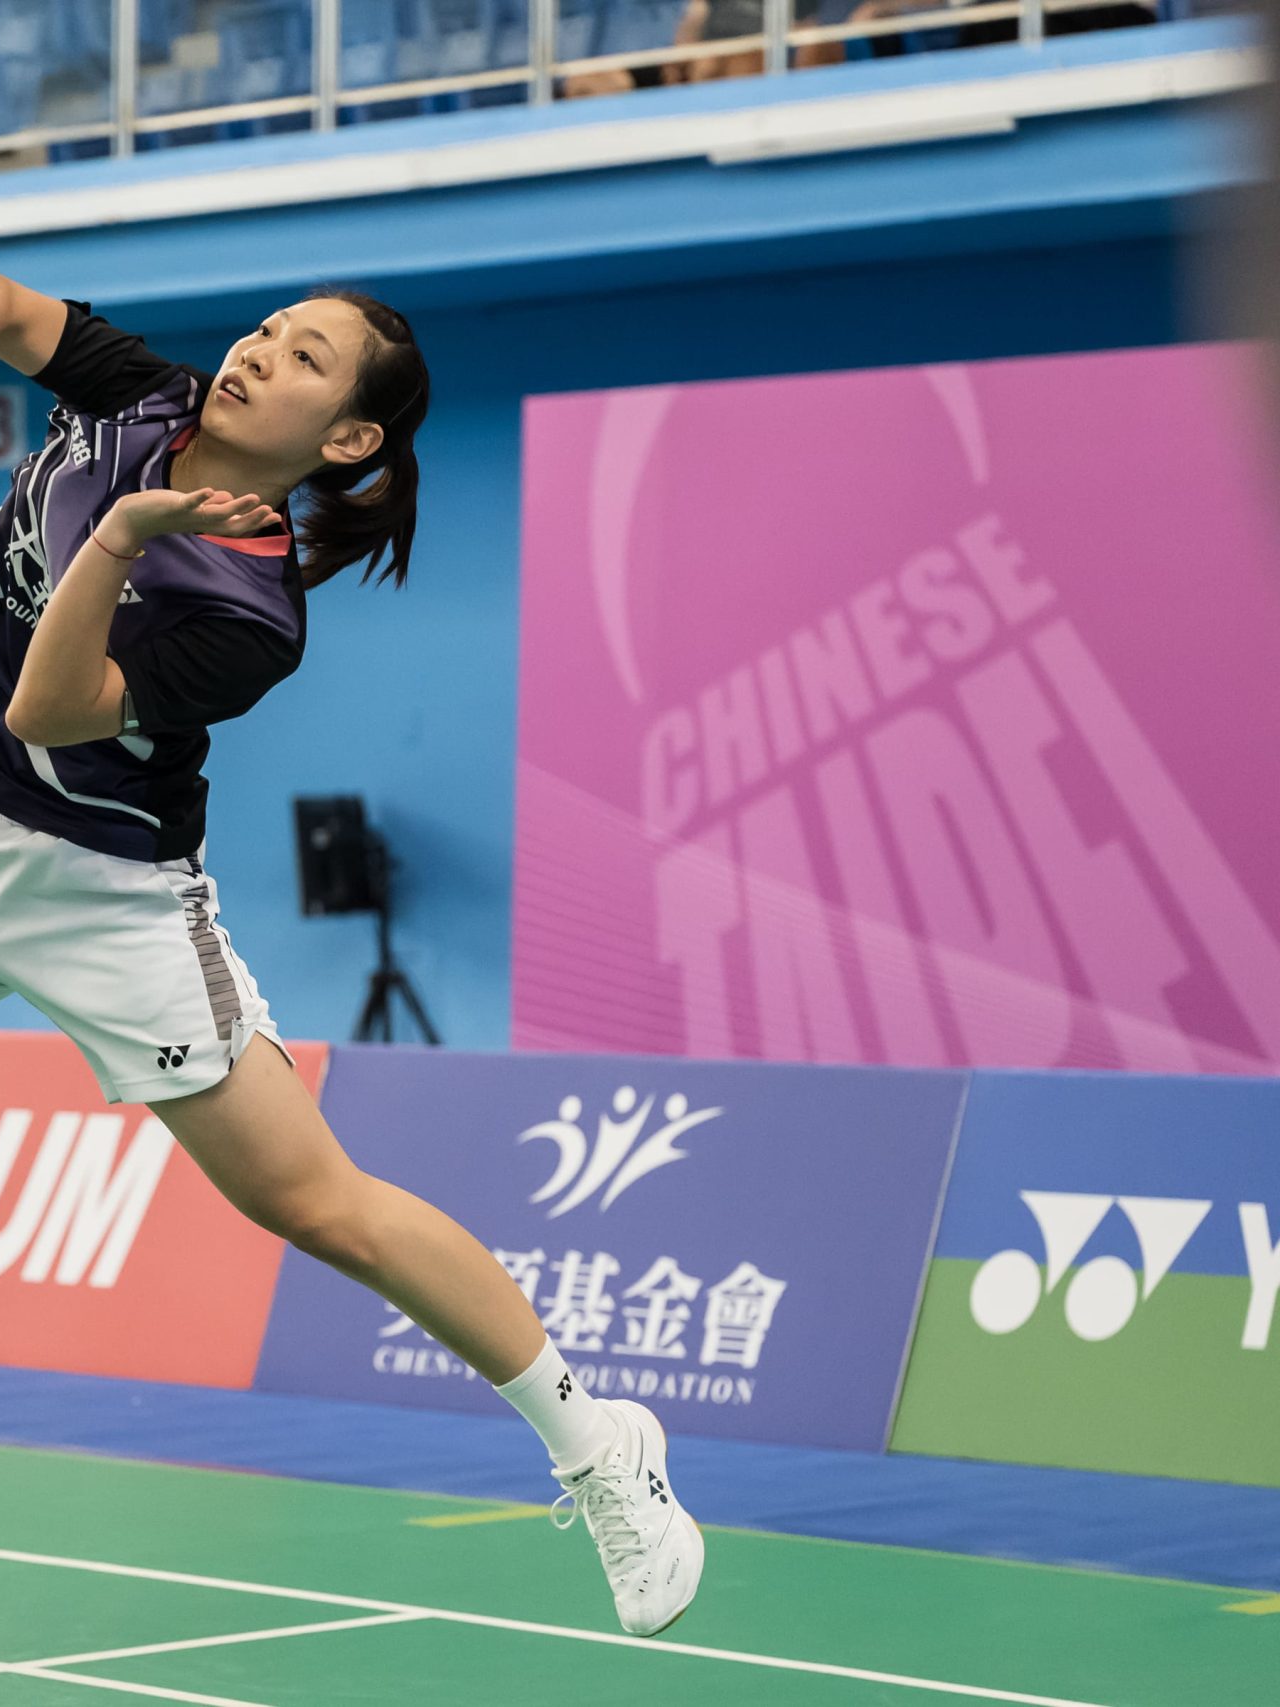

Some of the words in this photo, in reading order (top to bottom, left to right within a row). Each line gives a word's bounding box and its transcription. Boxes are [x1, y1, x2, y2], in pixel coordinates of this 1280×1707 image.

[642, 514, 1057, 842] CHINESE
[377, 1248, 787, 1369] 基金會
[373, 1344, 478, 1381] CHEN-
[568, 1360, 756, 1405] OUNDATION
